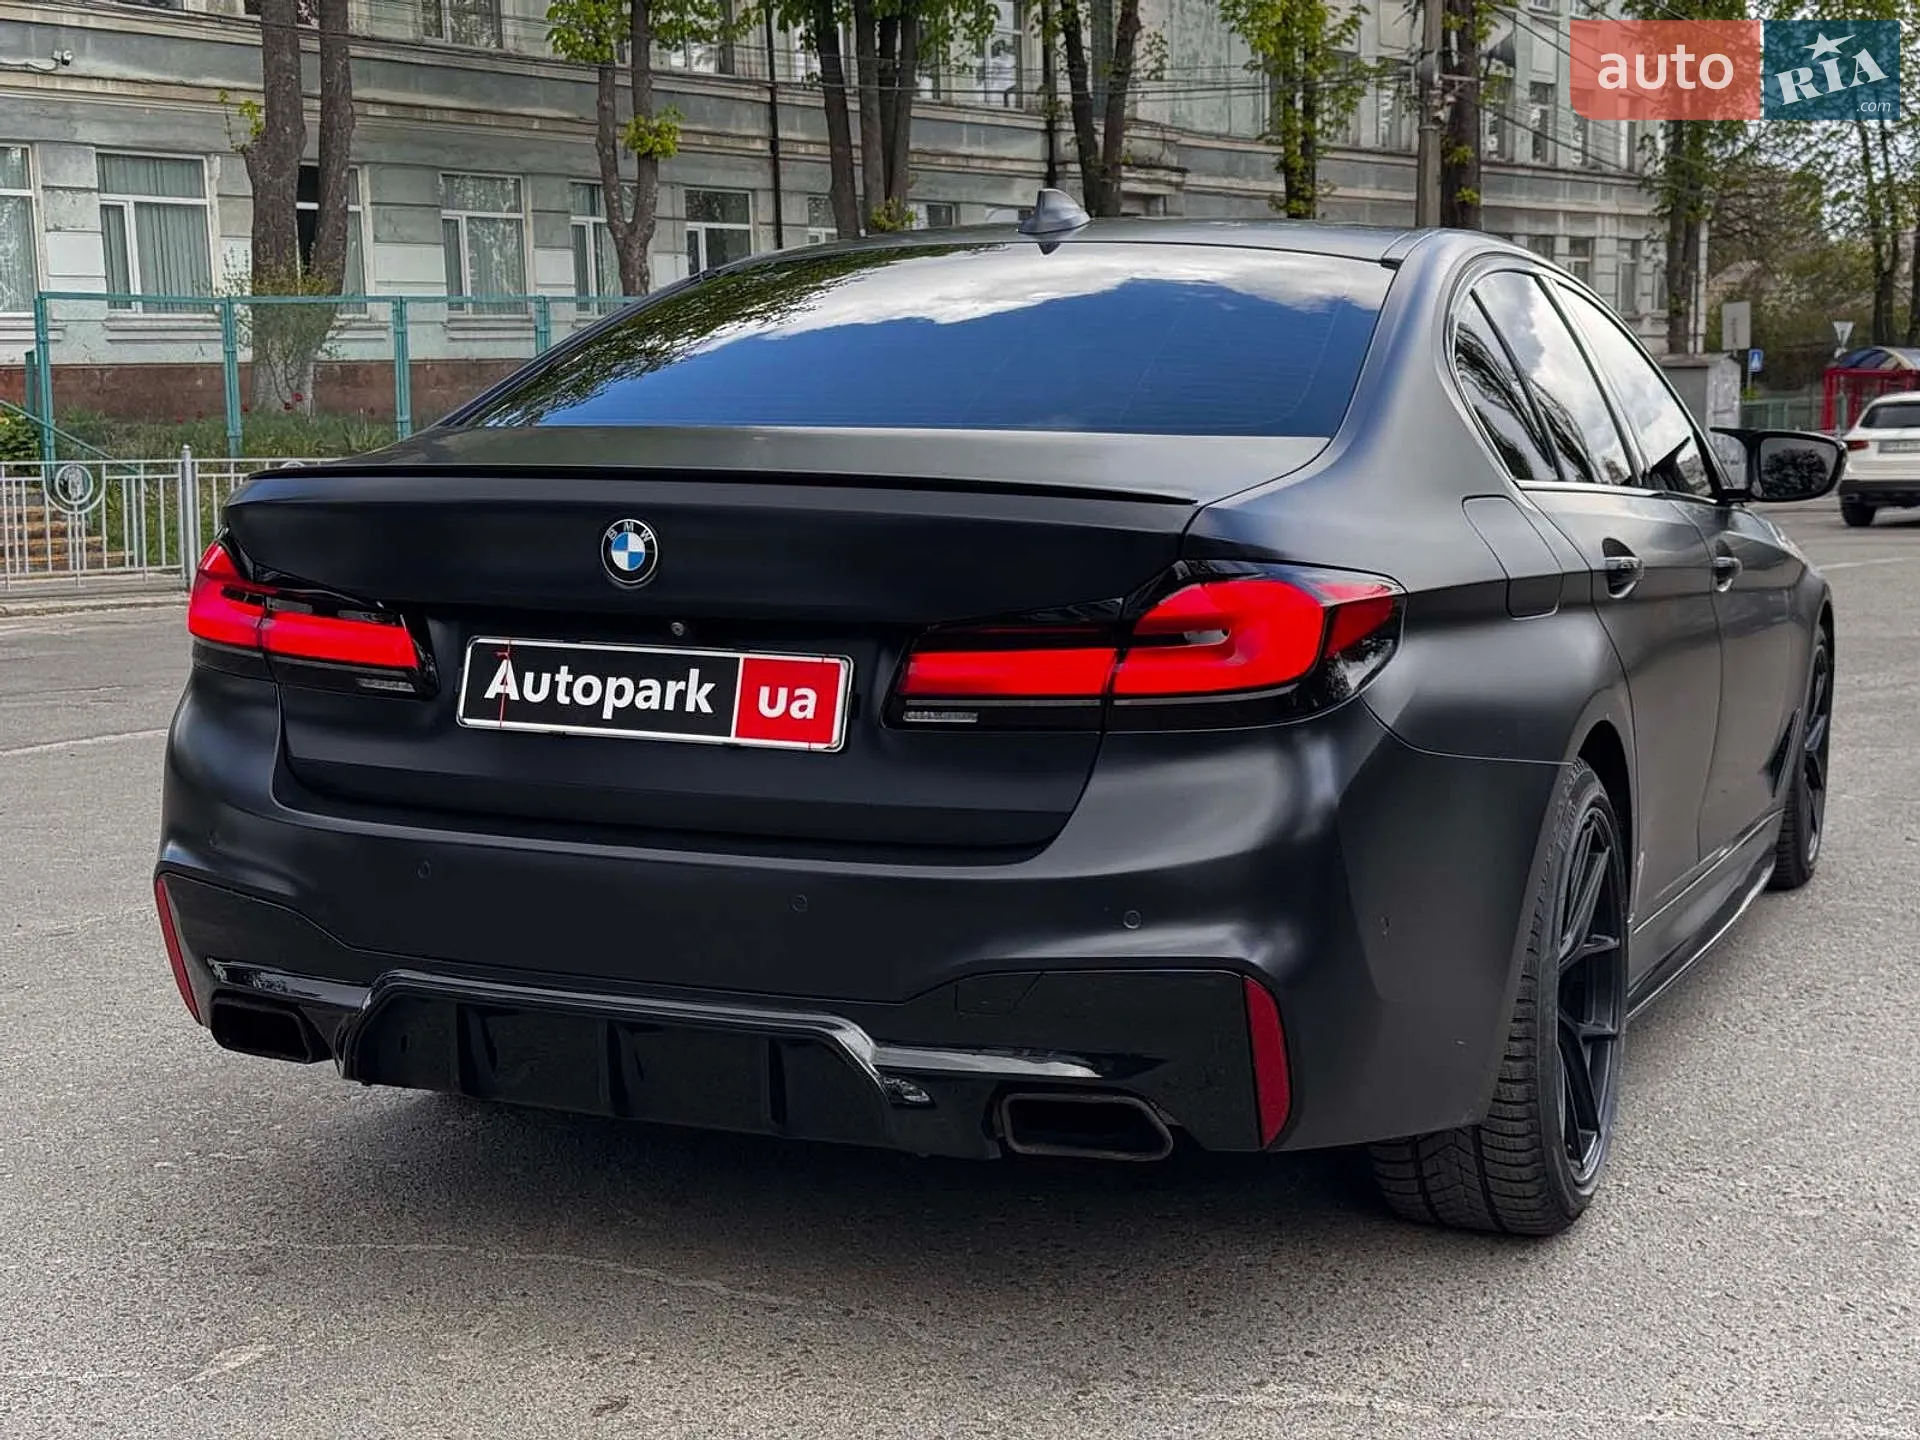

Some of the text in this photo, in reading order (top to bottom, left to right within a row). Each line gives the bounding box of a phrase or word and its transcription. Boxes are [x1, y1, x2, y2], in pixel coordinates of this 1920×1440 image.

[607, 521, 652, 542] BMW
[484, 659, 817, 719] Autopark ua
